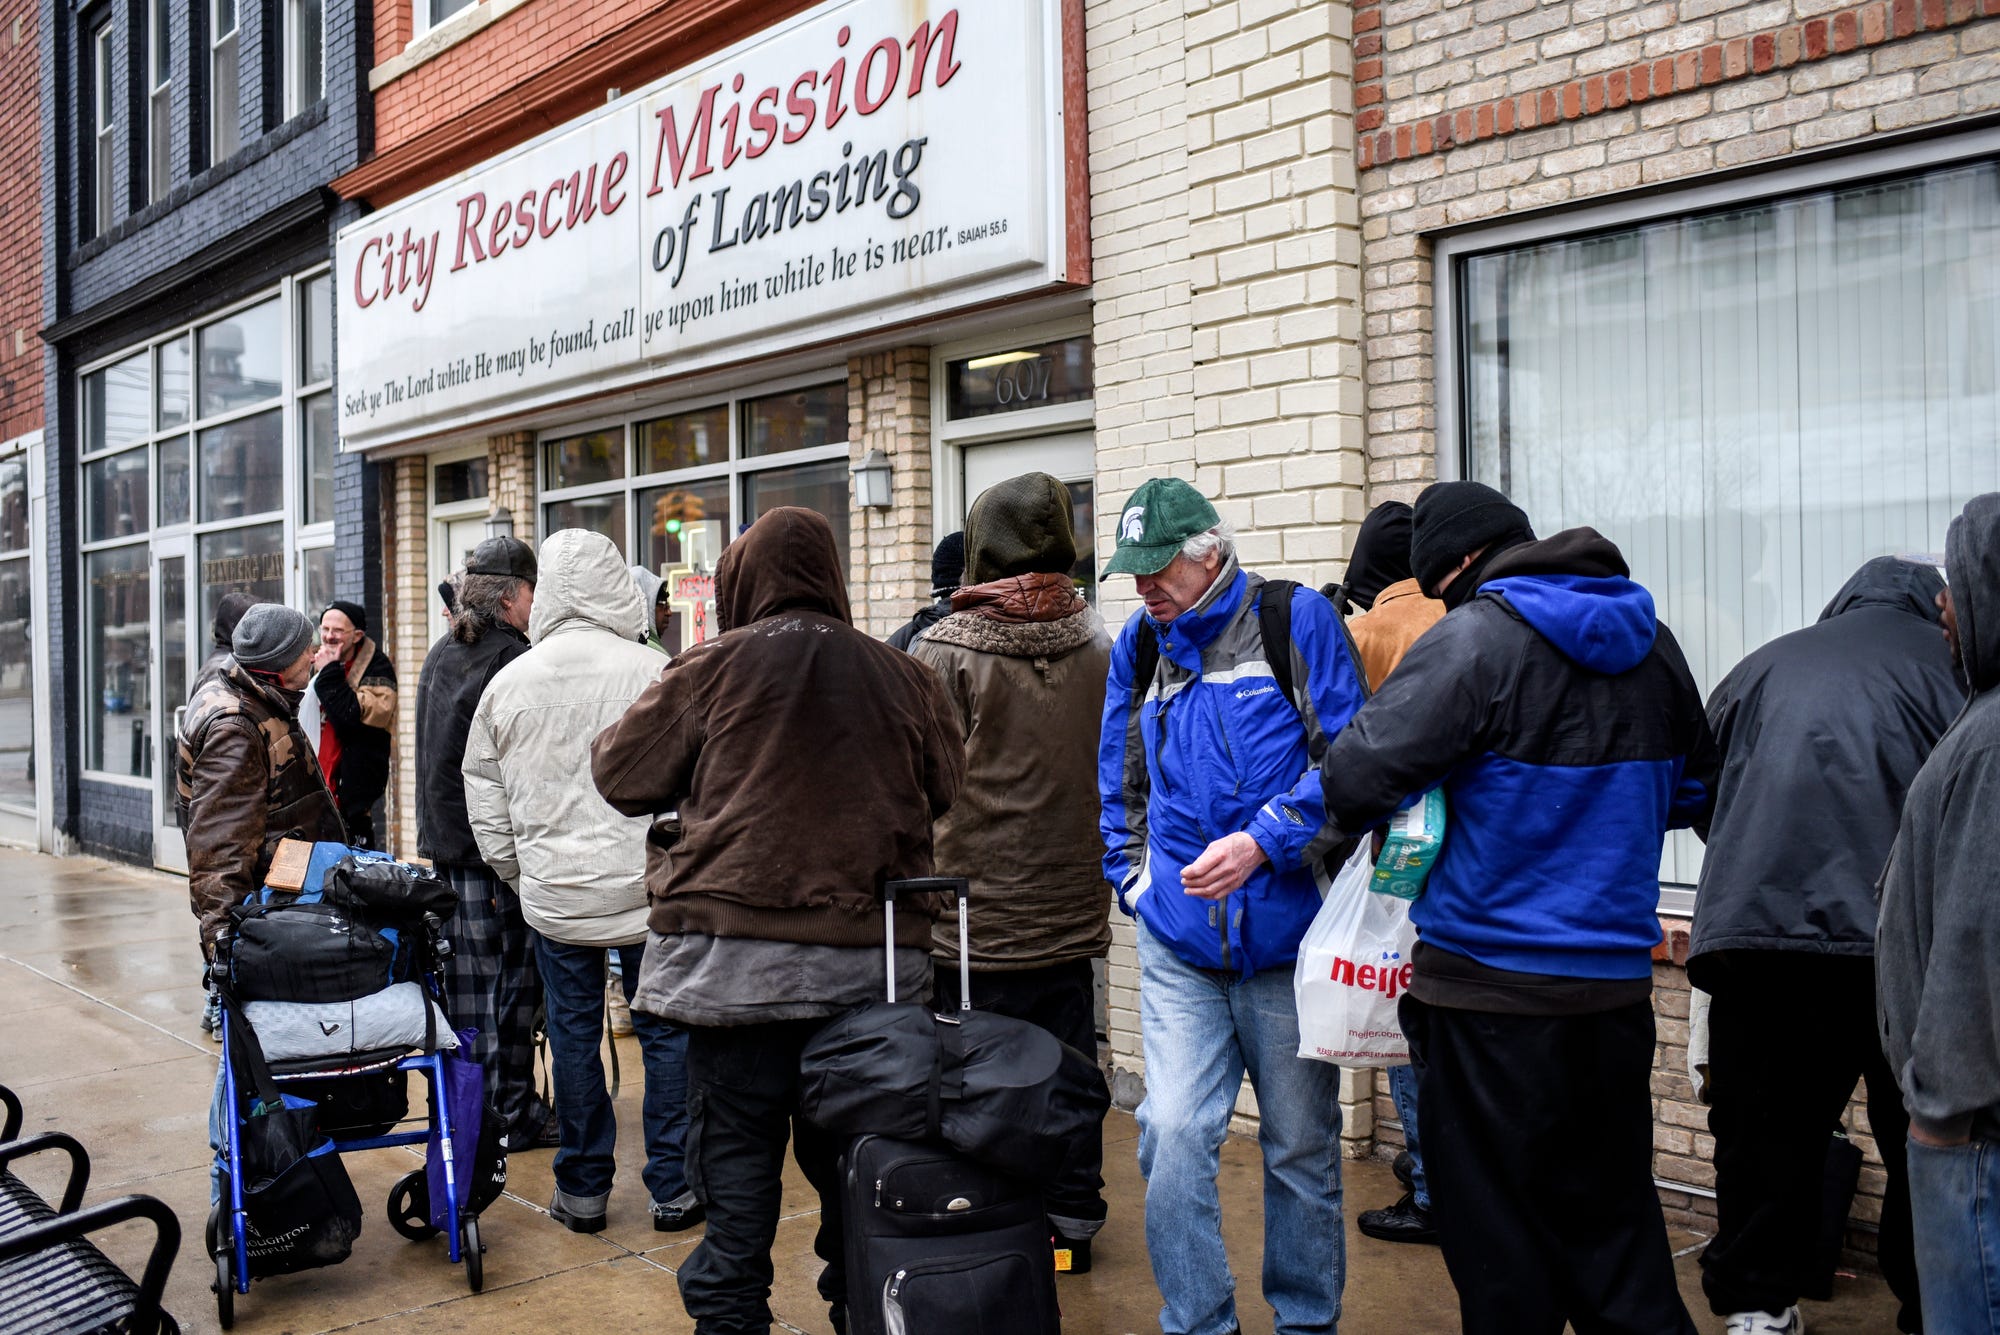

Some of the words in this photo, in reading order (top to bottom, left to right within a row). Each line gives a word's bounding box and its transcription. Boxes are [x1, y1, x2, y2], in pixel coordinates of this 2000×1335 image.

[354, 227, 440, 312] City
[450, 151, 628, 273] Rescue
[647, 8, 961, 197] Mission
[652, 193, 702, 288] of
[708, 136, 928, 253] Lansing
[957, 225, 988, 246] ISAIAH
[989, 218, 1008, 236] 55.6
[345, 388, 367, 417] Seek
[370, 389, 382, 418] ye
[384, 379, 404, 406] The
[407, 368, 434, 399] Lord
[437, 358, 472, 390] while
[475, 352, 493, 380] He
[496, 347, 526, 376] may
[530, 336, 545, 364] be
[548, 318, 598, 368] found,
[603, 307, 635, 344] call
[644, 308, 664, 344] ye
[668, 293, 715, 334] upon
[720, 278, 759, 313] him
[765, 254, 825, 299] while
[831, 246, 857, 281] he
[865, 237, 884, 272] is
[891, 225, 952, 265] near.
[995, 357, 1053, 405] 607
[674, 575, 716, 599] JESU
[1243, 685, 1275, 697] Columbia
[1330, 951, 1415, 999] meije
[1316, 1047, 1333, 1057] PLEASE
[1348, 1028, 1403, 1040] meijer.com
